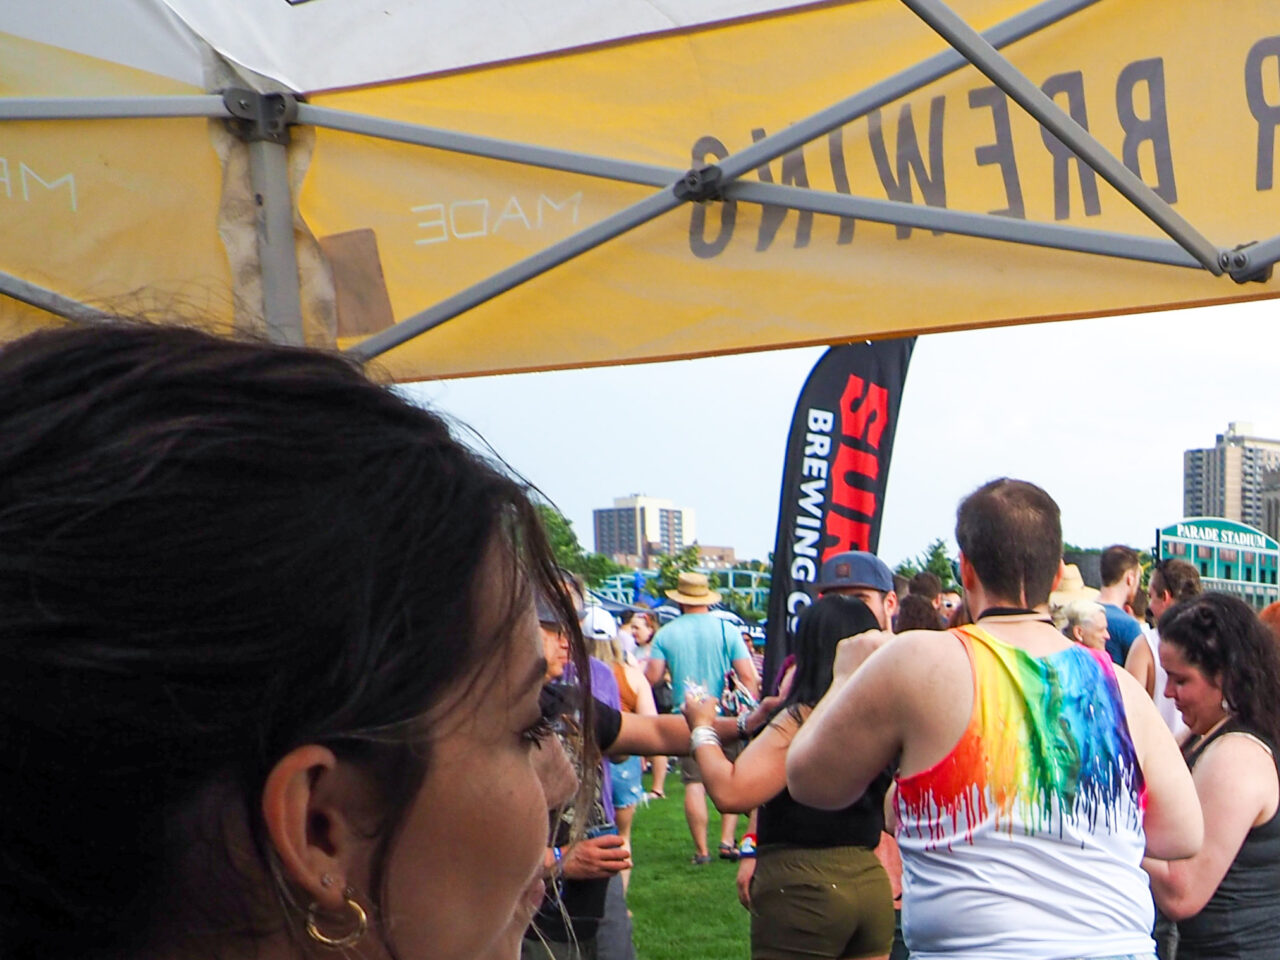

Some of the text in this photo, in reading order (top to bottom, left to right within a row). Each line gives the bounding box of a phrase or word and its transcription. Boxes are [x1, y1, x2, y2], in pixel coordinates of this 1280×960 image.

[791, 407, 835, 583] BREWING
[1176, 523, 1266, 548] PARADE STADIUM
